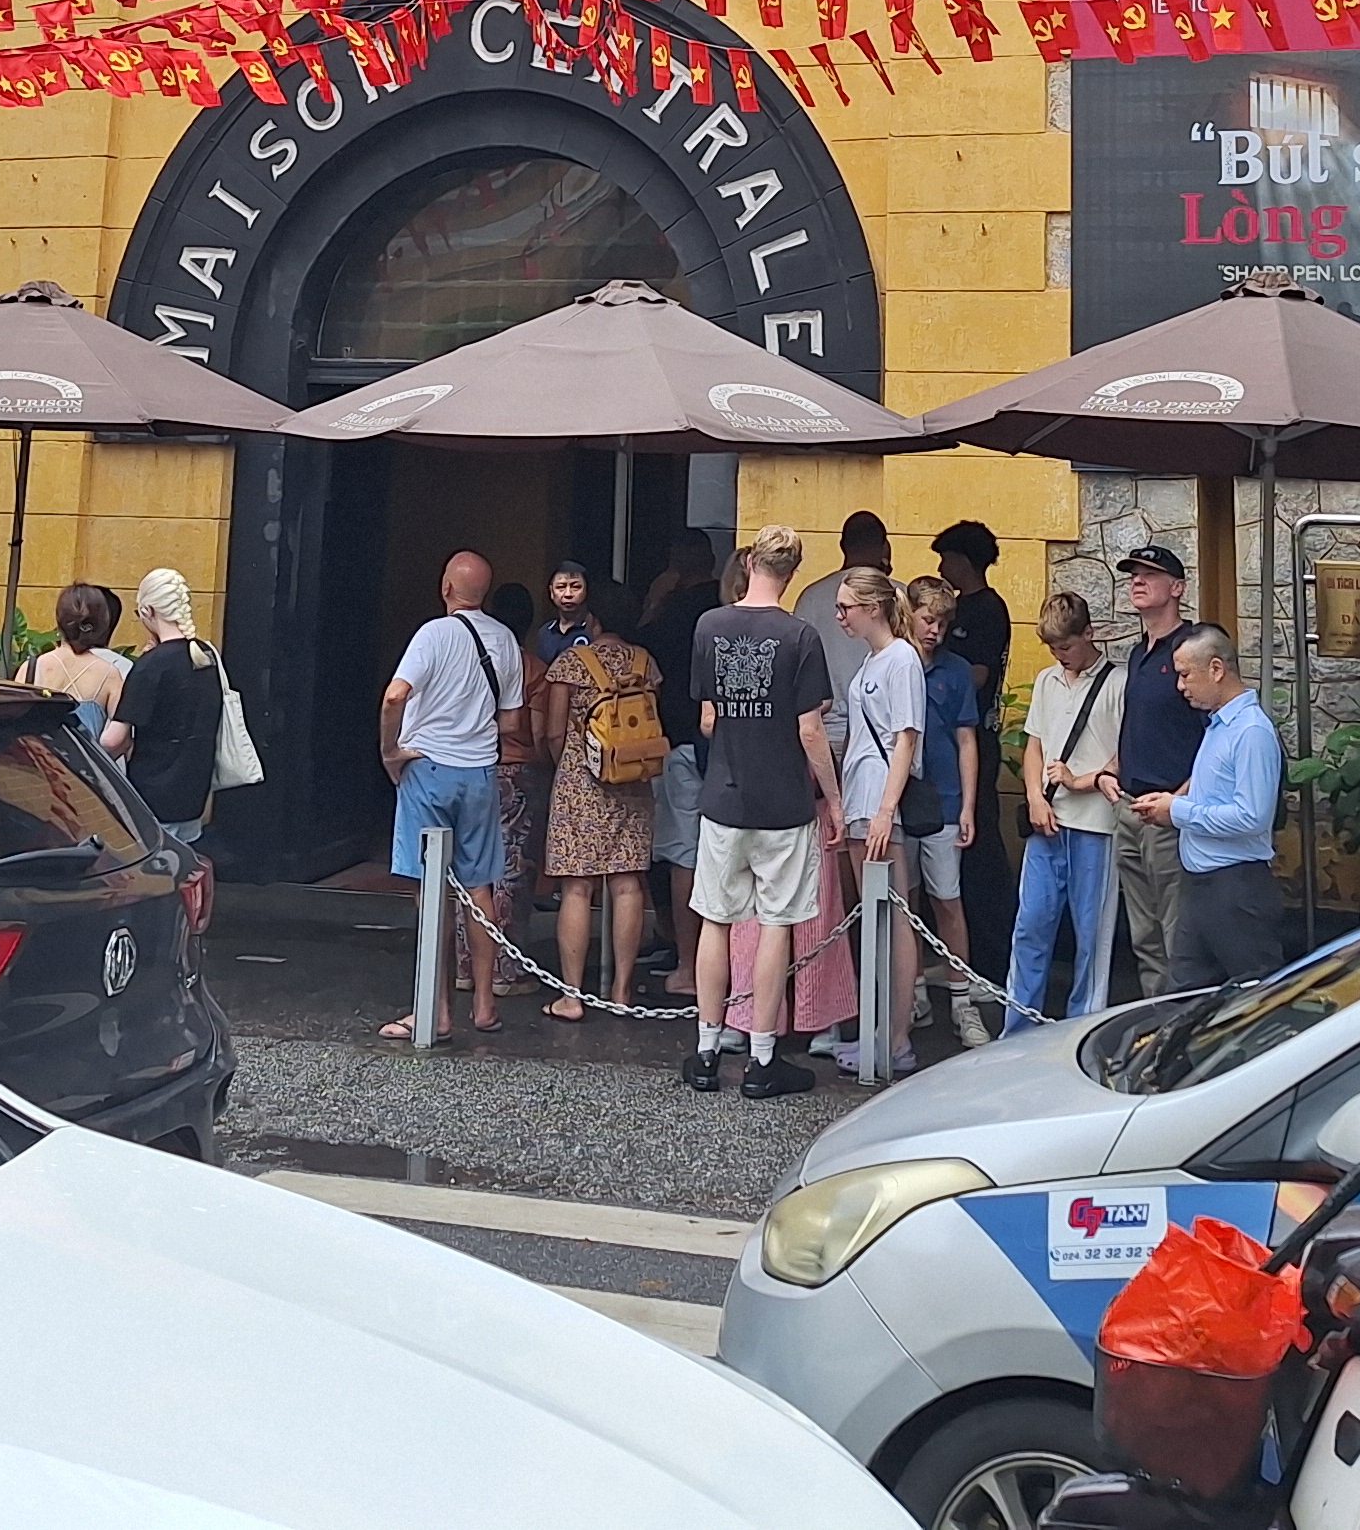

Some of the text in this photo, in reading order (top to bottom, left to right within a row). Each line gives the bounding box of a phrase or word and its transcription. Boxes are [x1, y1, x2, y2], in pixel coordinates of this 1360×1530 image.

[1180, 190, 1349, 259] Lòng
[1293, 266, 1335, 283] PEN,
[16, 398, 84, 408] PRISON
[1164, 400, 1240, 409] PRISON
[717, 702, 772, 718] DICKIES
[1106, 1204, 1148, 1222] TAXI
[1085, 1249, 1100, 1259] 32
[1105, 1248, 1121, 1259] 32
[1125, 1247, 1142, 1258] 32
